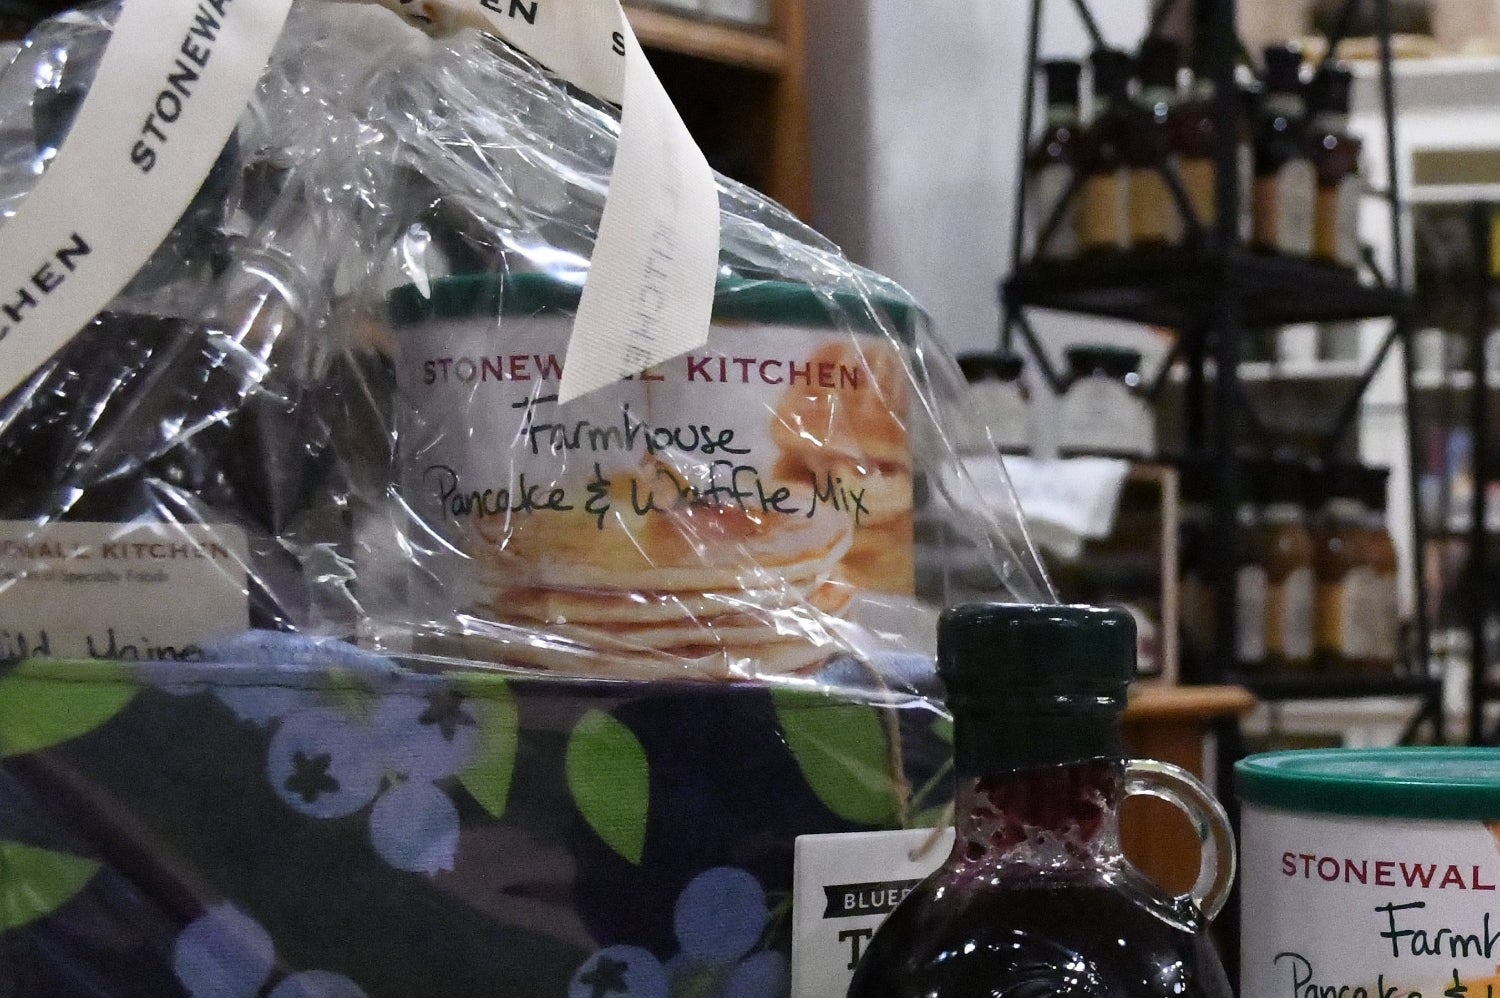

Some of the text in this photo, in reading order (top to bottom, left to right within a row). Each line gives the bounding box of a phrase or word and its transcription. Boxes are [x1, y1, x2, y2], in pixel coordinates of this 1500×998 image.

[0, 233, 91, 341] HEN
[423, 354, 859, 390] STONEW KITCHEN
[511, 395, 750, 455] Farmhouse
[423, 460, 869, 529] Pancake & Waffle Mix
